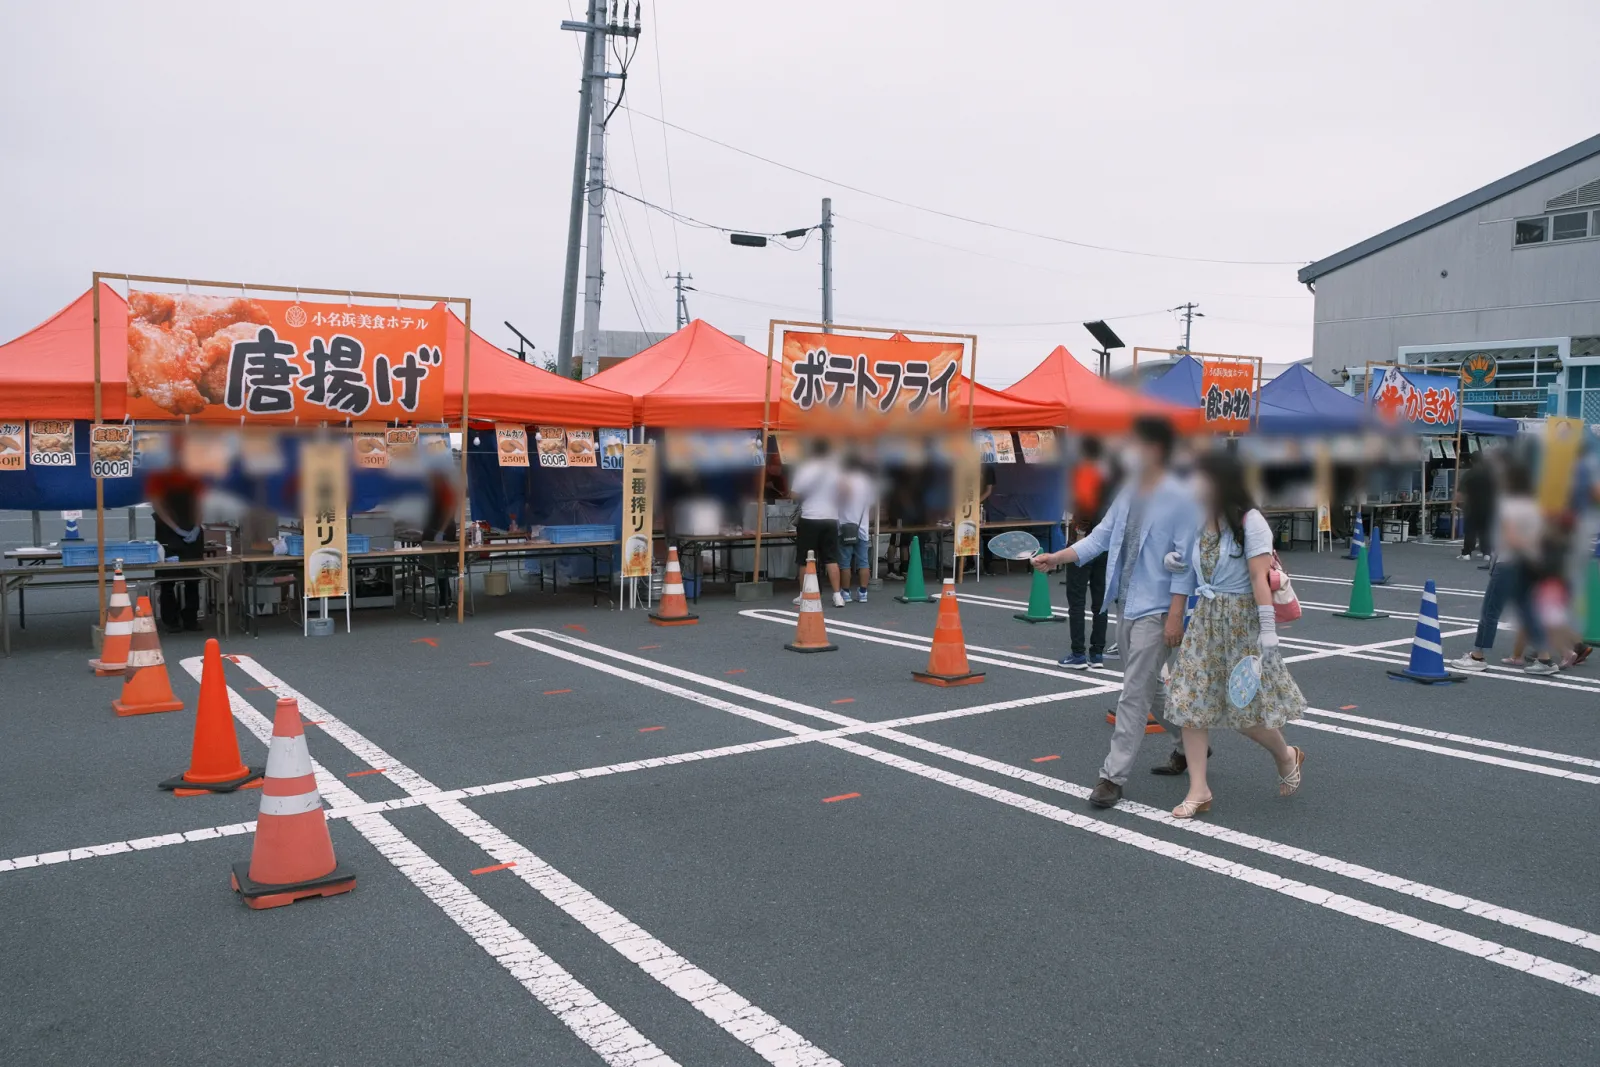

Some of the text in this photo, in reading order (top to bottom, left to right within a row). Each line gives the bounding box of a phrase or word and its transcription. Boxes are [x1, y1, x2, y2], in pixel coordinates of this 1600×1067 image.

[311, 311, 429, 330] 小名浜美食ホテル
[225, 327, 442, 415] 唐揚げ
[792, 347, 957, 413] ポテトフライ
[1201, 383, 1251, 421] 飲み物
[1512, 391, 1541, 401] Hotel
[0, 424, 21, 435] カツ
[0, 457, 20, 466] 0円
[33, 453, 72, 464] 600円
[501, 455, 526, 464] 250円
[541, 454, 567, 466] 600円
[569, 455, 594, 464] 250円
[93, 462, 129, 476] 600円
[631, 468, 647, 532] 一番搾り
